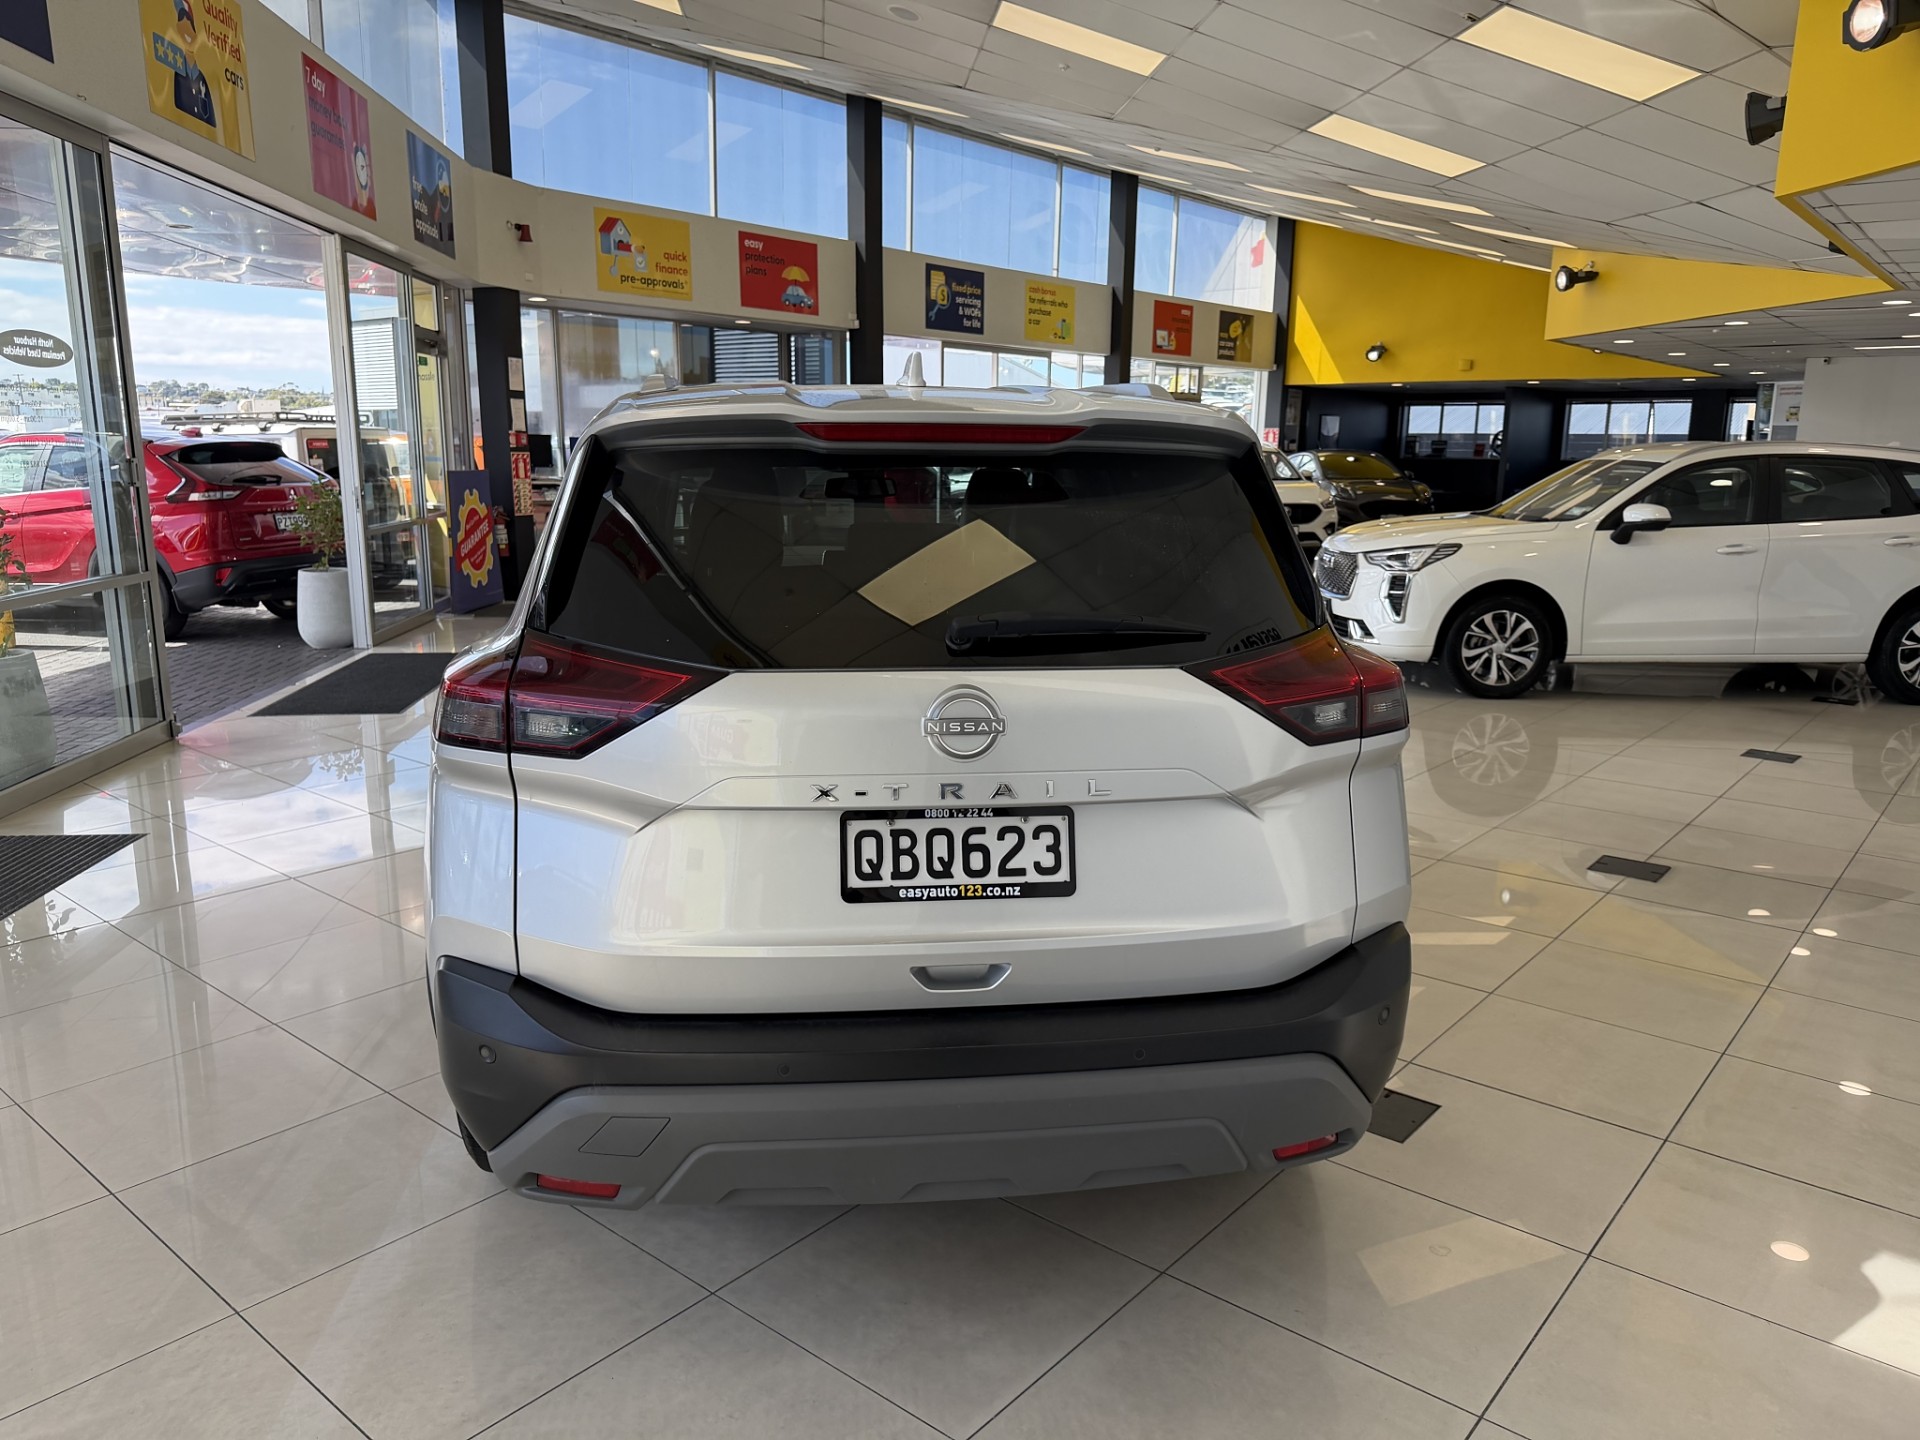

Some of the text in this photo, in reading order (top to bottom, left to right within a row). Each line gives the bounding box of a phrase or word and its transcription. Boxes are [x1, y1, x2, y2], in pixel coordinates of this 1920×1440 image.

[202, 0, 238, 38] Quality
[203, 20, 242, 63] Verified
[224, 67, 244, 91] cars
[311, 72, 326, 98] day
[744, 239, 764, 251] easy
[663, 250, 688, 263] quick
[745, 252, 785, 265] protection
[655, 262, 689, 276] finance
[745, 265, 767, 276] plans
[955, 296, 981, 308] servicing
[963, 317, 971, 327] for
[460, 519, 490, 557] GUARANTEE
[927, 722, 1004, 732] NISSAN
[810, 779, 1112, 802] X-TRAIL
[924, 808, 949, 818] 0800
[966, 808, 979, 818] 22
[981, 807, 994, 818] 44
[853, 824, 1062, 882] QBQ623
[898, 884, 1021, 900] easyauto123.co.nz
